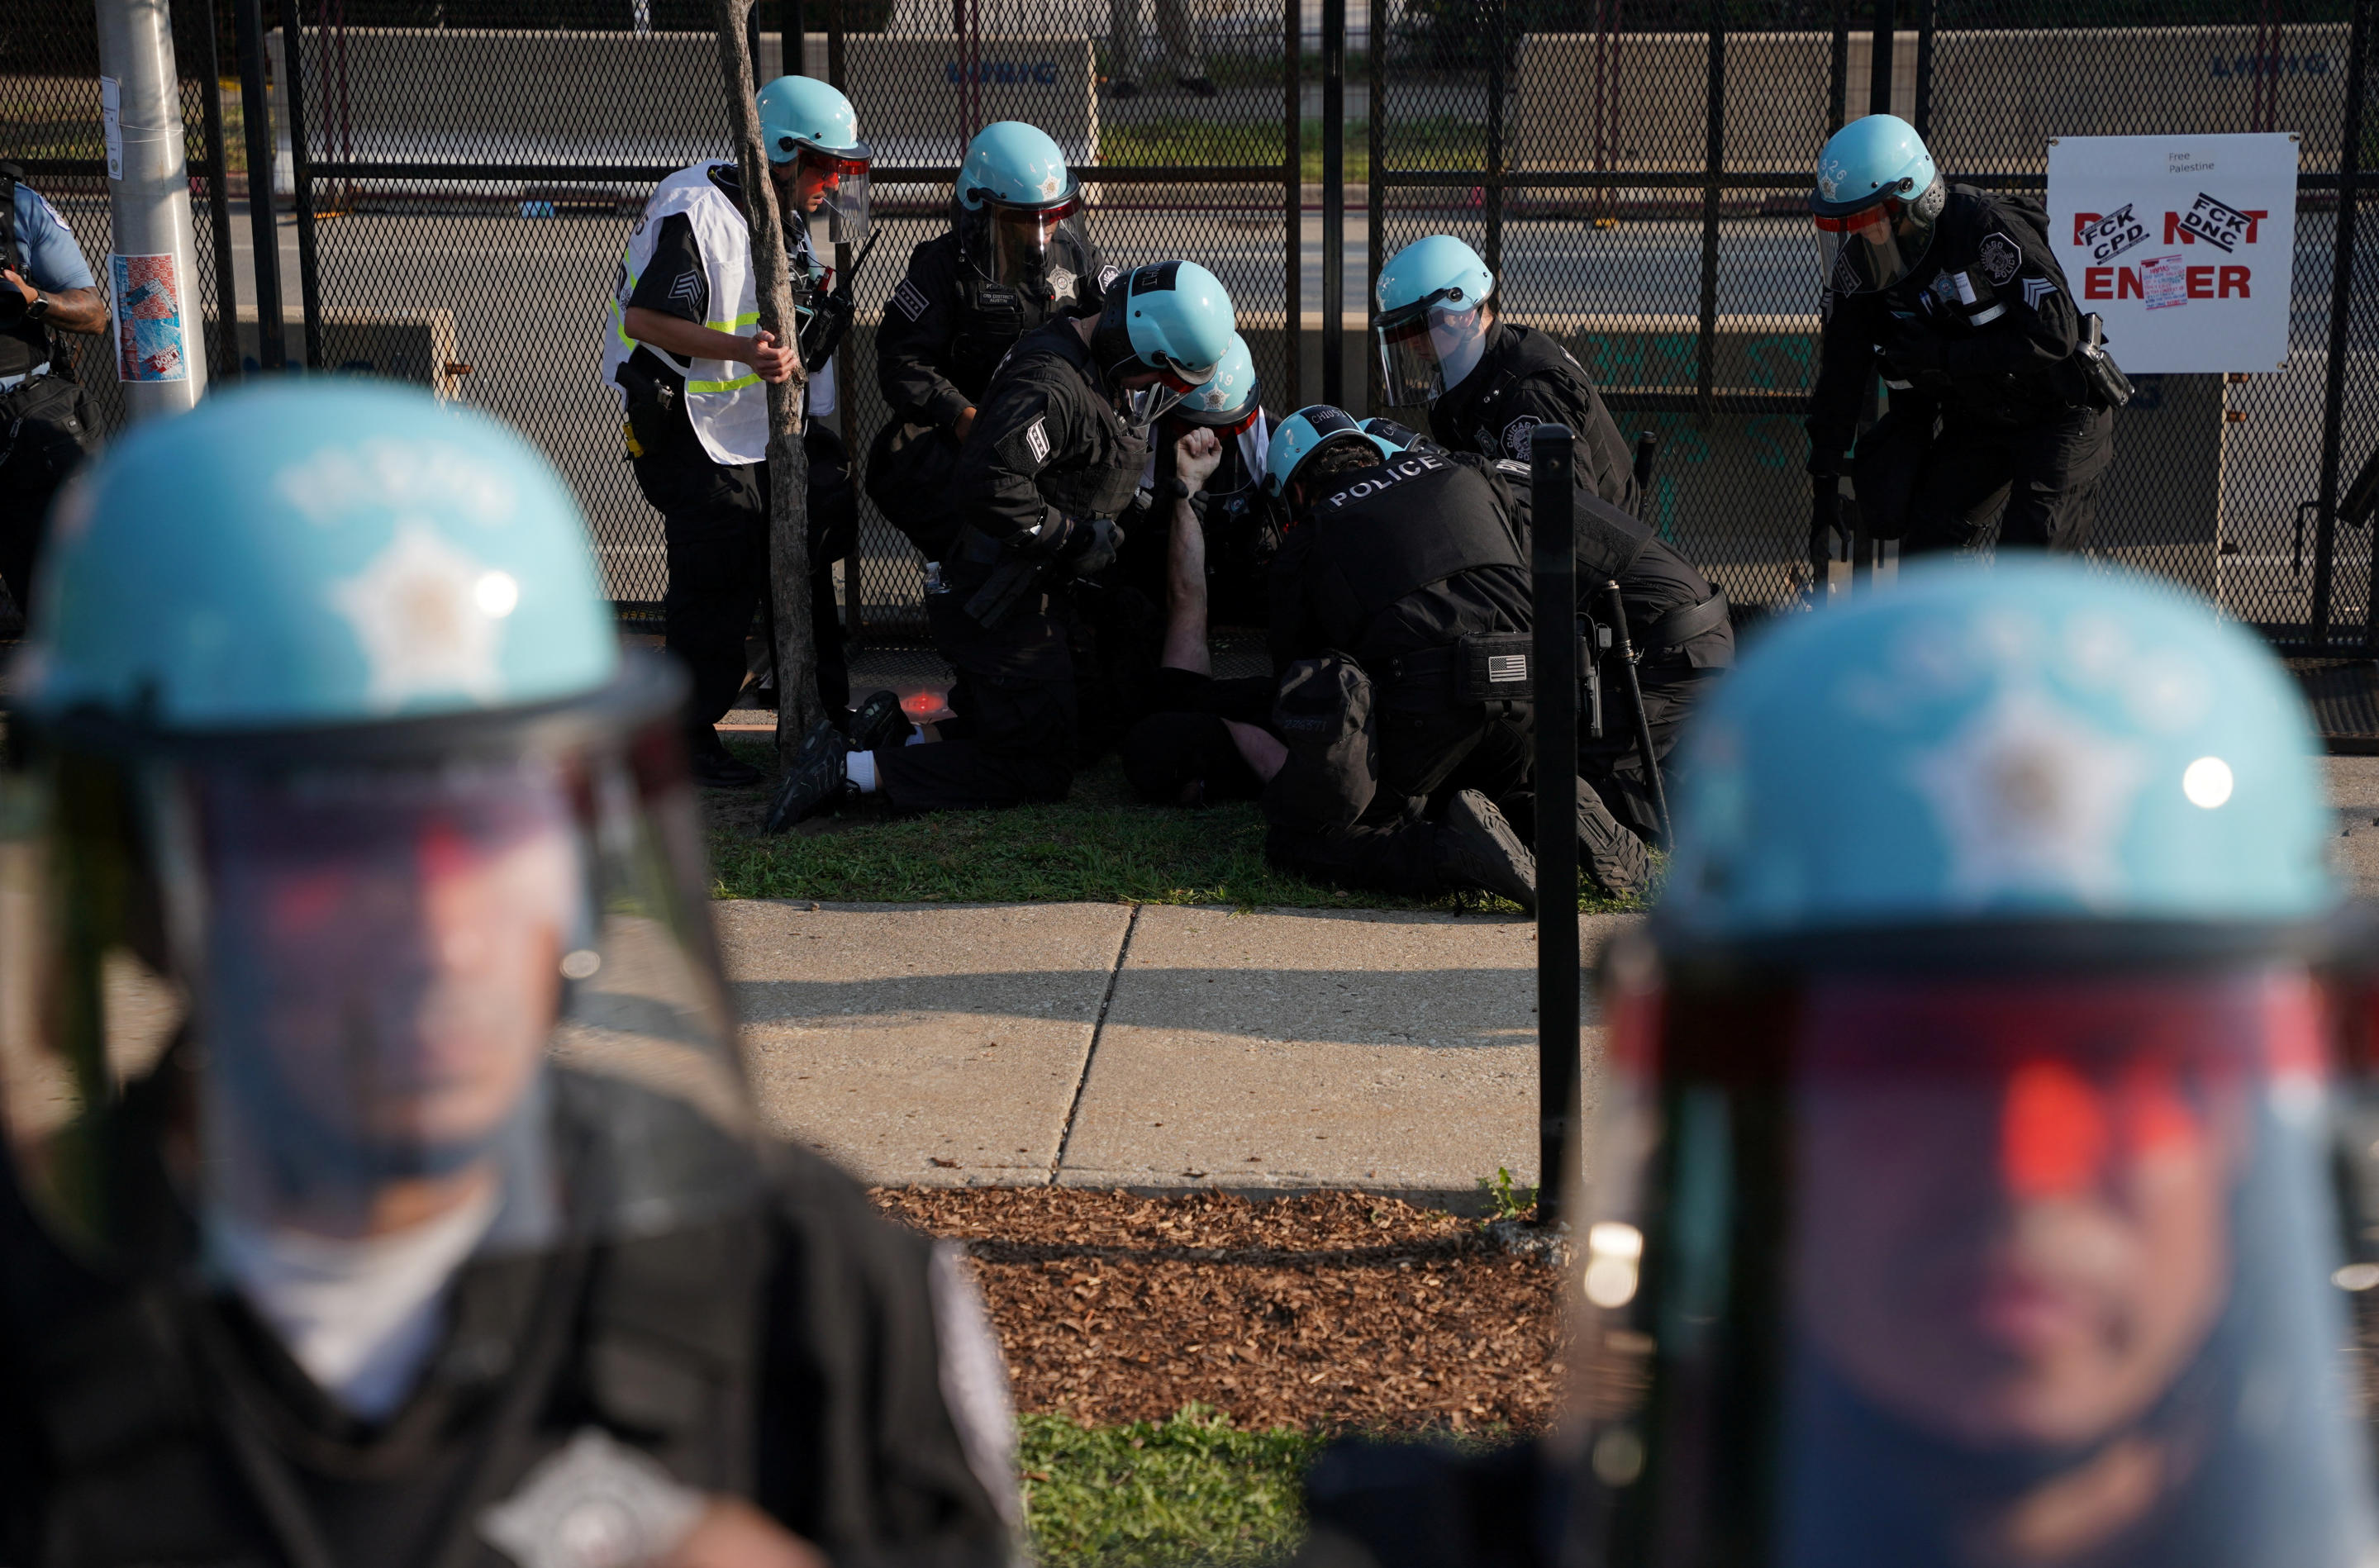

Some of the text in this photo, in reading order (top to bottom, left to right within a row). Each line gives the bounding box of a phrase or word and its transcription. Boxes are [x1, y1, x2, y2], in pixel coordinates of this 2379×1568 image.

[2168, 152, 2191, 162] Free
[2169, 161, 2215, 173] Palestine
[2085, 208, 2136, 246] FCK
[2163, 210, 2267, 245] NT
[2184, 211, 2238, 245] DNC
[2192, 197, 2247, 234] FCK
[2094, 224, 2143, 259] CPD
[2084, 265, 2252, 300] ENER
[155, 349, 180, 368] DON'T
[1329, 455, 1444, 507] POLICE
